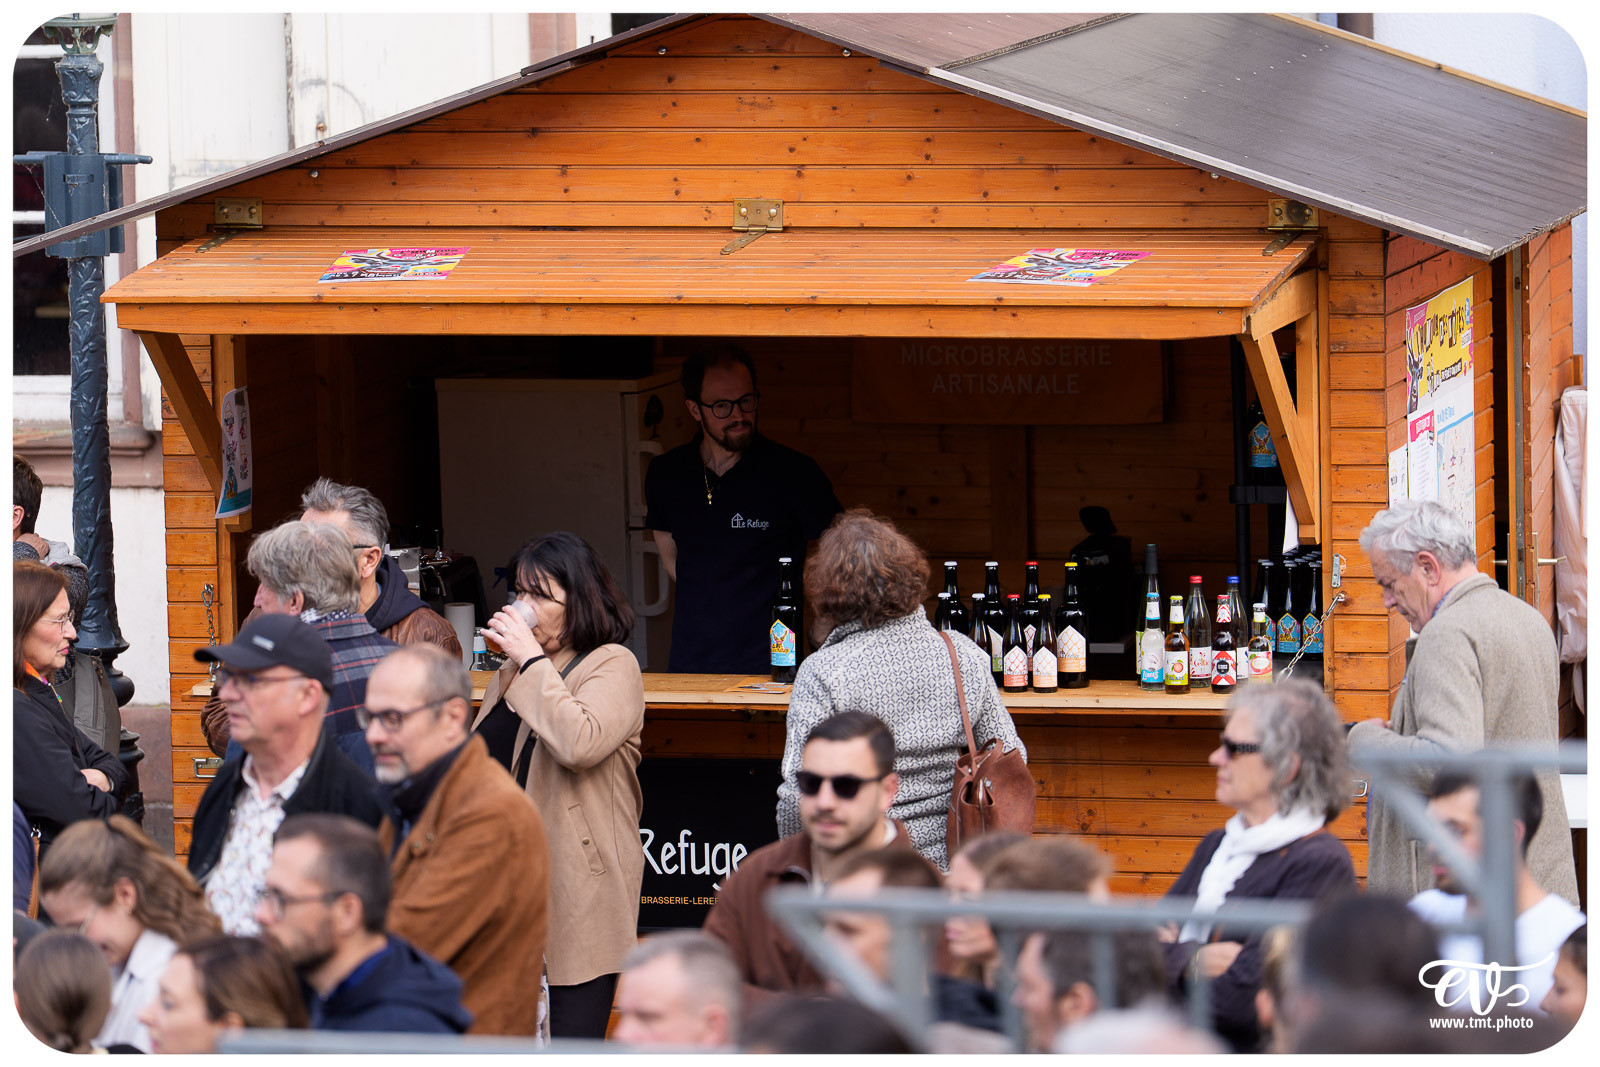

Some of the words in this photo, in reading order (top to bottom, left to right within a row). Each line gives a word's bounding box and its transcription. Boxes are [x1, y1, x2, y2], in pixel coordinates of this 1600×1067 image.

[901, 345, 1112, 366] MICROBRASSERIE
[931, 373, 1081, 394] ARTISANALE
[747, 519, 770, 530] Refuge
[639, 828, 748, 891] Refuge
